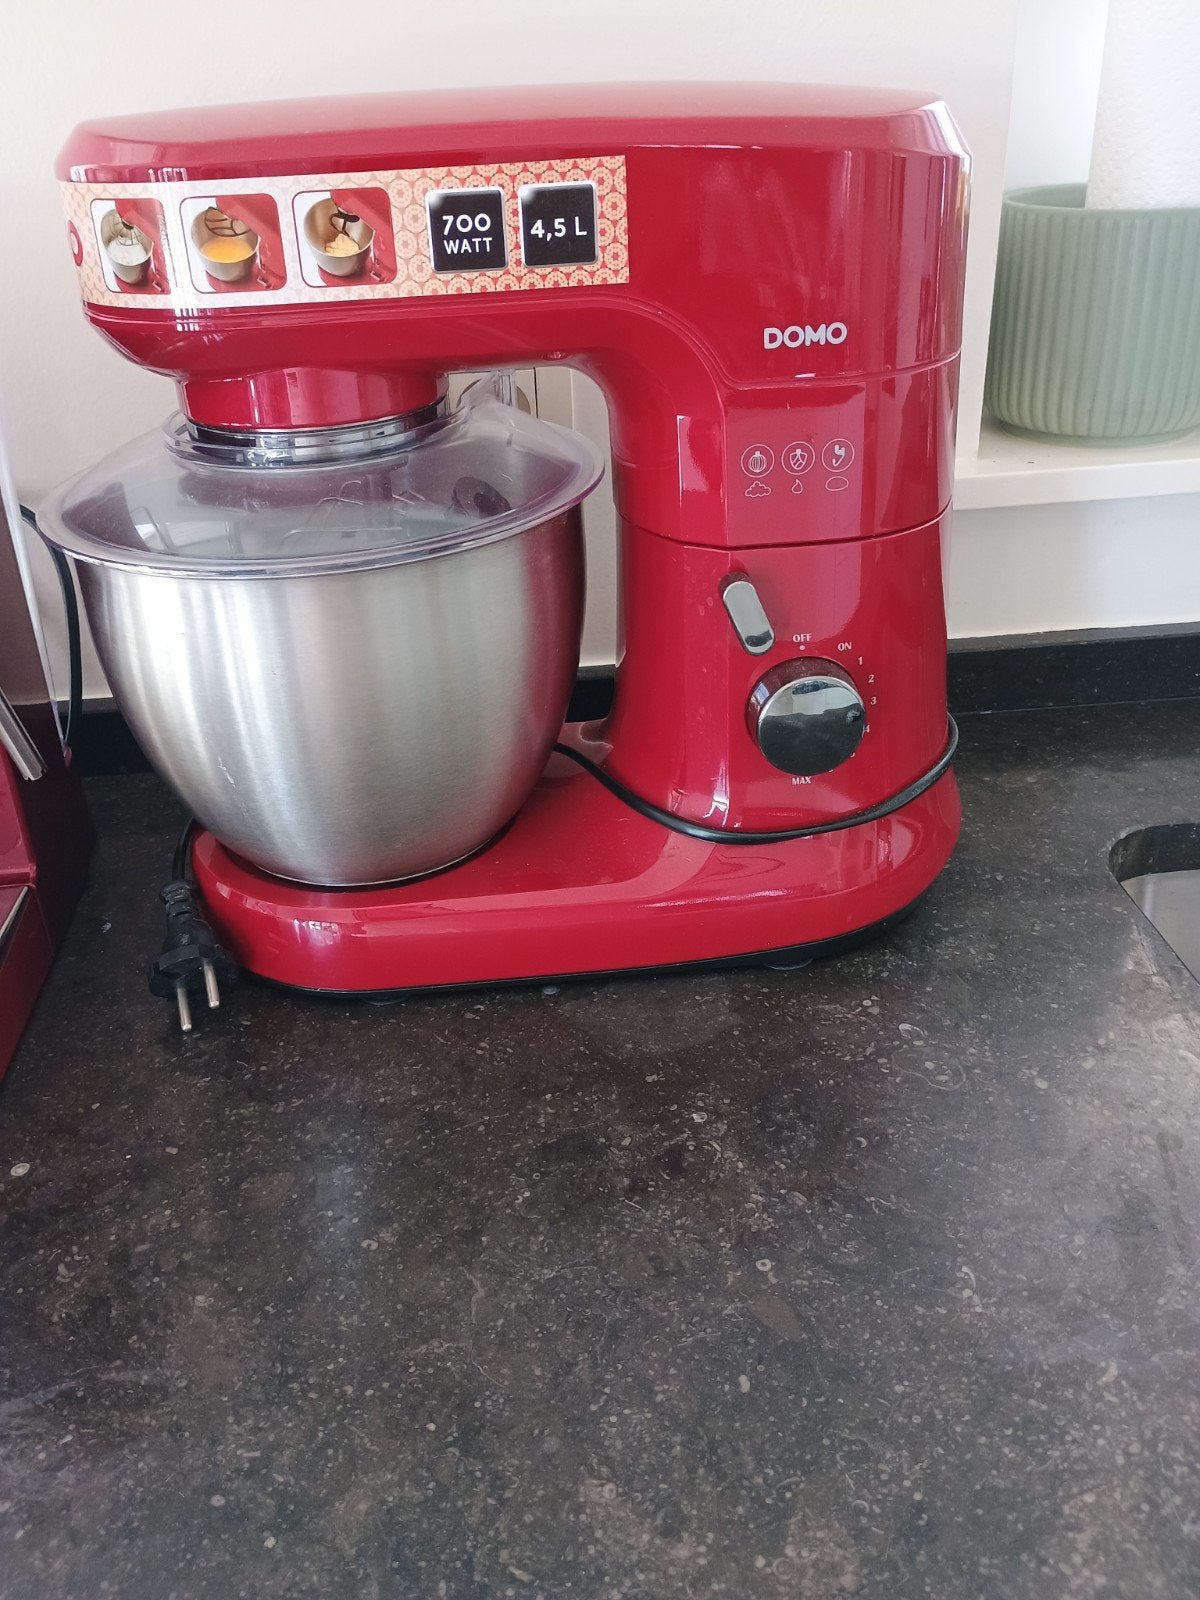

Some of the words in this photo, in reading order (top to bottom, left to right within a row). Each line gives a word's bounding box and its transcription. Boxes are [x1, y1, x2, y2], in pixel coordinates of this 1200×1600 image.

[442, 213, 491, 236] 700
[530, 218, 566, 242] 4,5
[574, 216, 588, 236] L
[443, 237, 493, 255] WATT
[763, 322, 848, 350] DOMO
[792, 633, 813, 643] OFF
[837, 642, 852, 651] ON
[858, 656, 863, 665] 1
[868, 674, 875, 683] 2
[870, 696, 877, 705] 3
[791, 776, 812, 786] MAX
